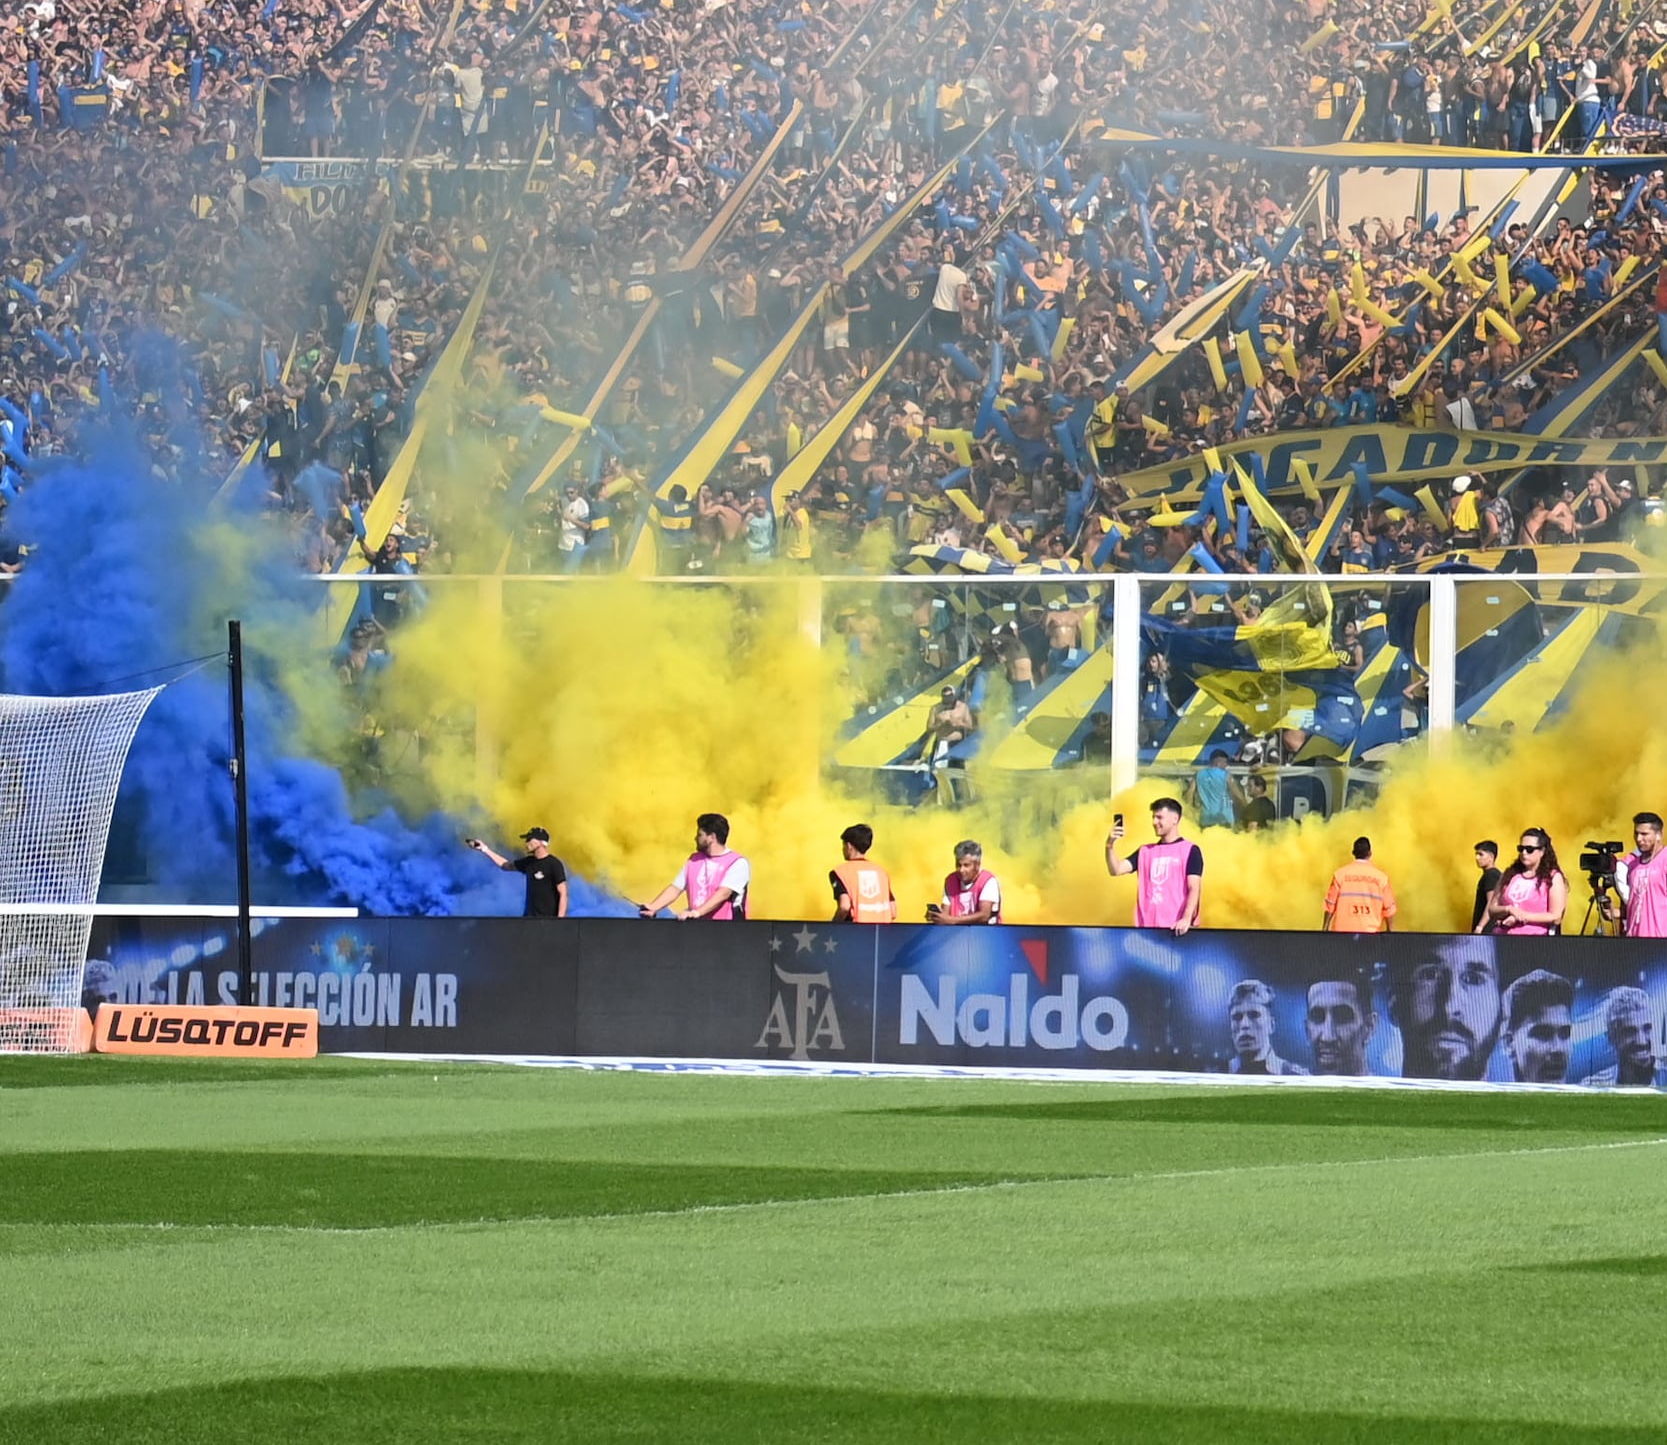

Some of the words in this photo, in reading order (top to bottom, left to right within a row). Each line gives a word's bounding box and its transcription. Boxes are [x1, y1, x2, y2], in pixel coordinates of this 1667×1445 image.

[1352, 905, 1371, 915] 313
[411, 973, 458, 1028] AR
[900, 973, 1129, 1052] Naldo
